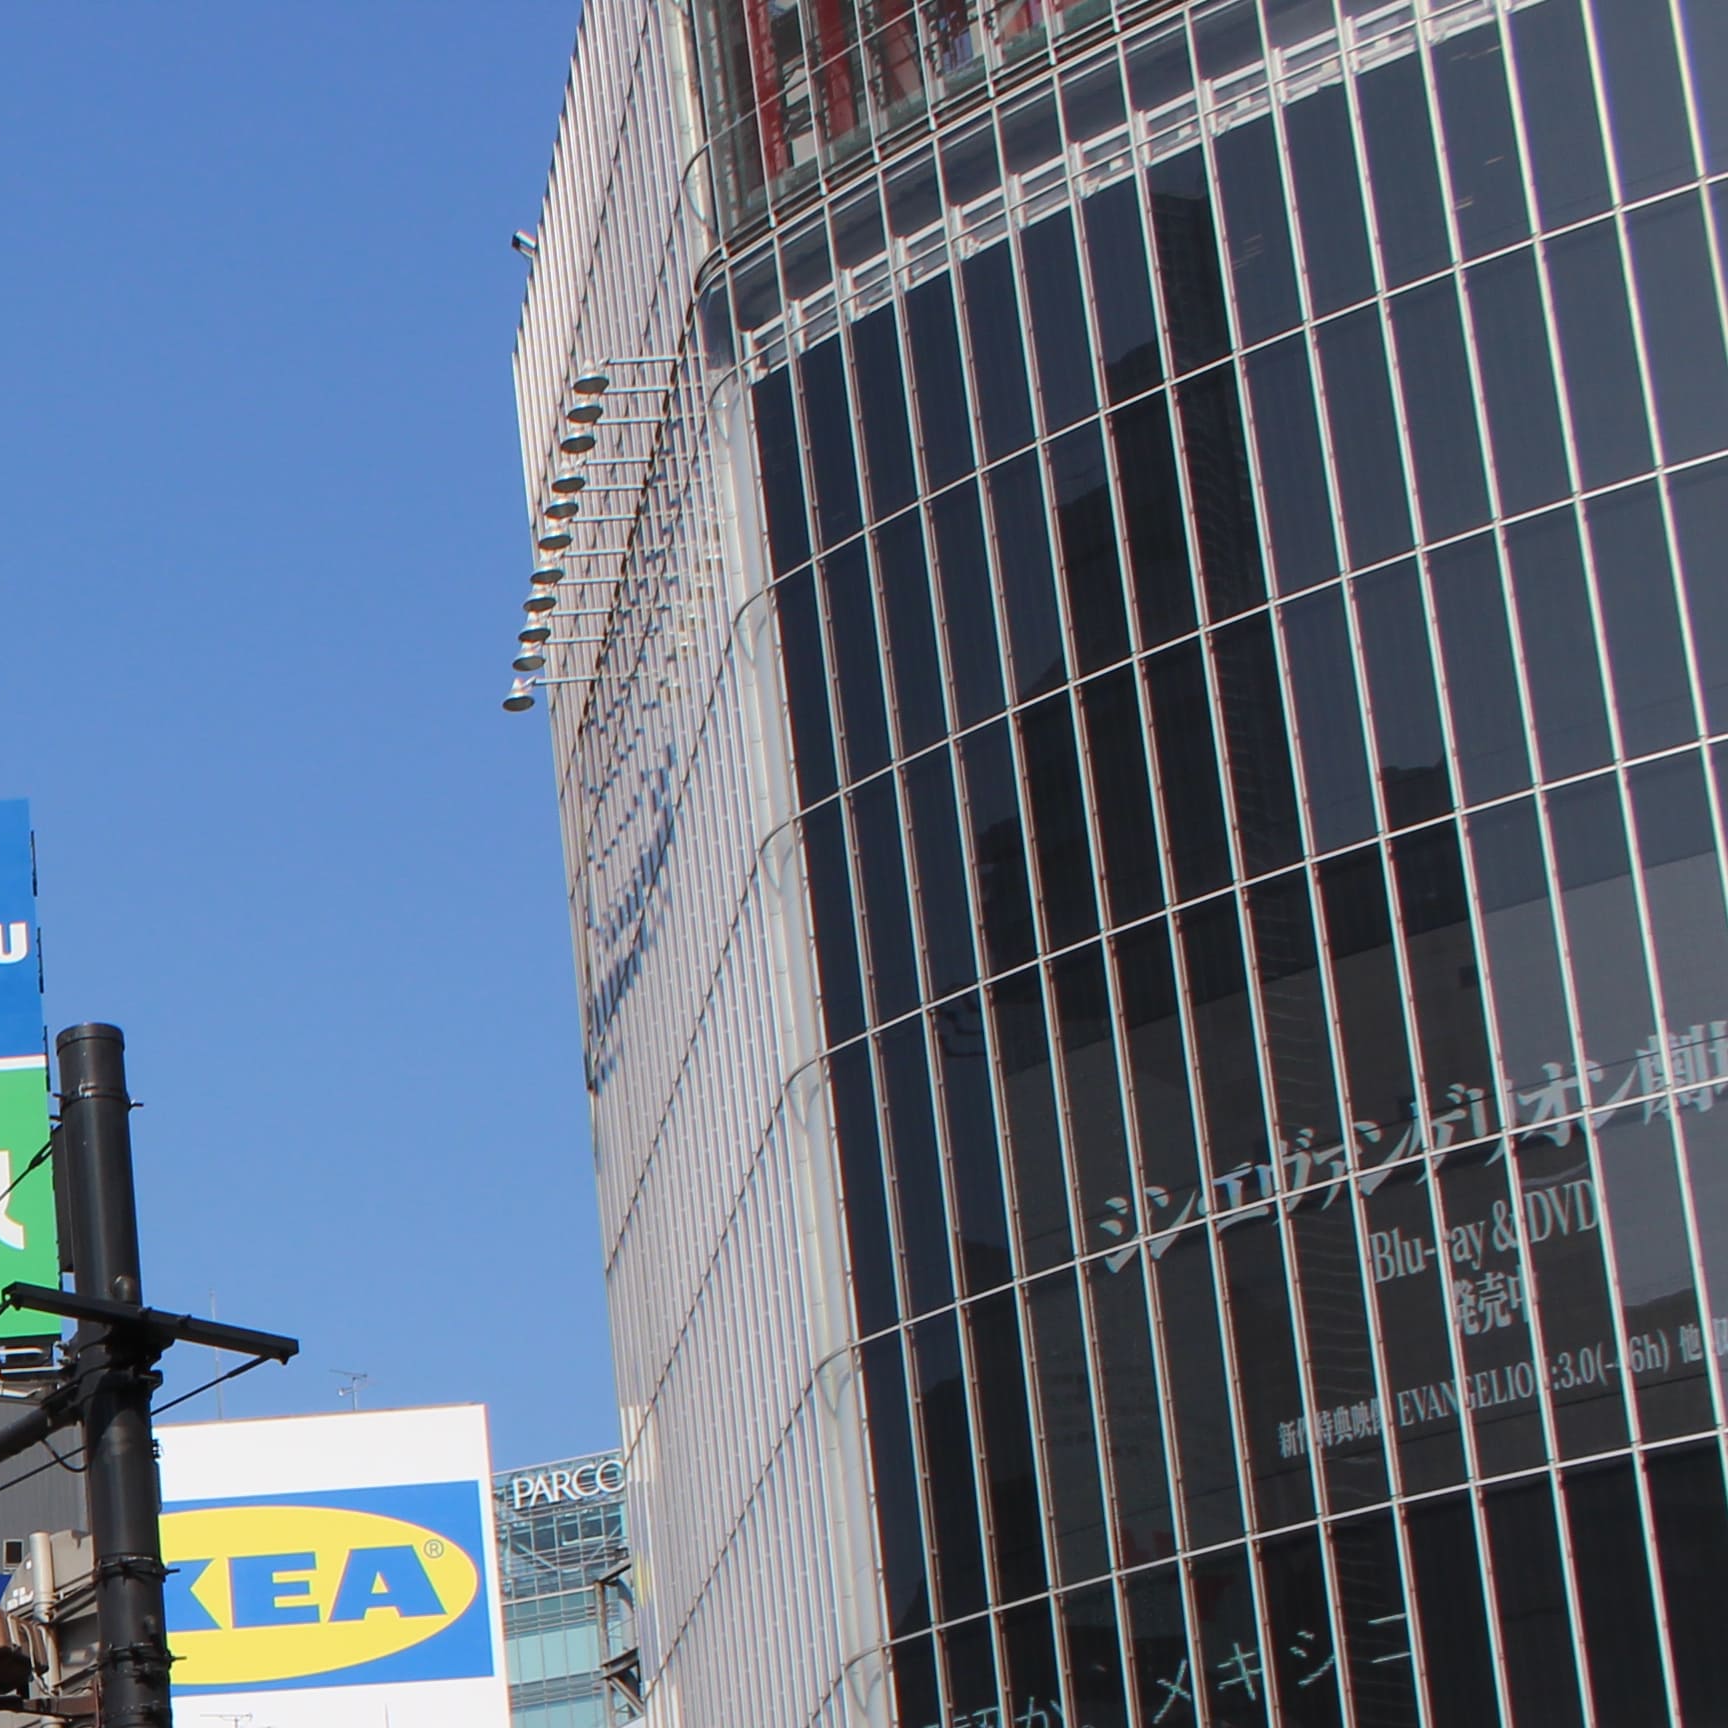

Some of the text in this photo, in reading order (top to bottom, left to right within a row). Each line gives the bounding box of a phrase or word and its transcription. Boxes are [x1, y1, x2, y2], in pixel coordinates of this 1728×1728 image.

[1524, 1177, 1601, 1245] DVD
[1450, 1263, 1539, 1338] 発売中
[512, 1458, 625, 1511] PARCO
[162, 1544, 448, 1635] KEA
